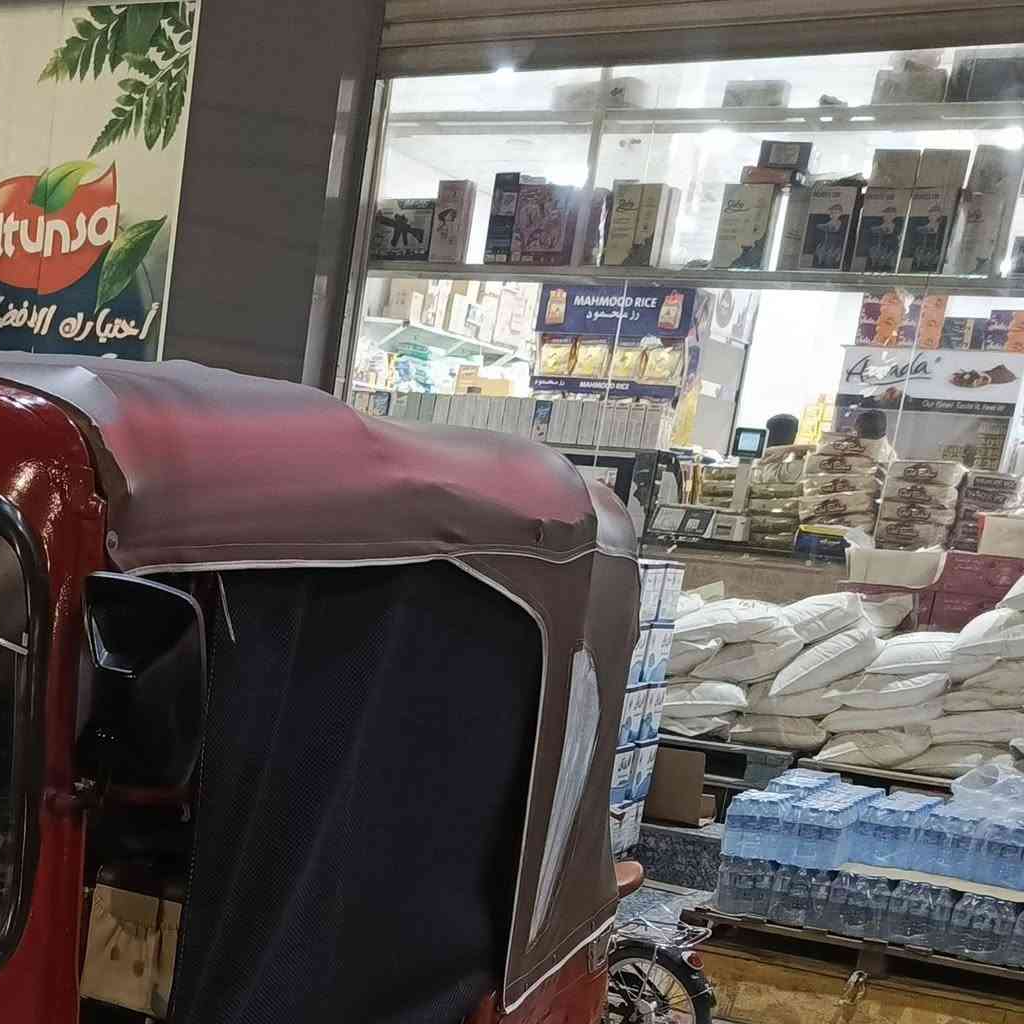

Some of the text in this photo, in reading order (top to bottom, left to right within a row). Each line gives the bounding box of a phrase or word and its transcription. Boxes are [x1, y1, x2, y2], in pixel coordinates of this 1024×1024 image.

[573, 296, 658, 308] MAHMOOD RICE
[846, 352, 932, 383] Aada
